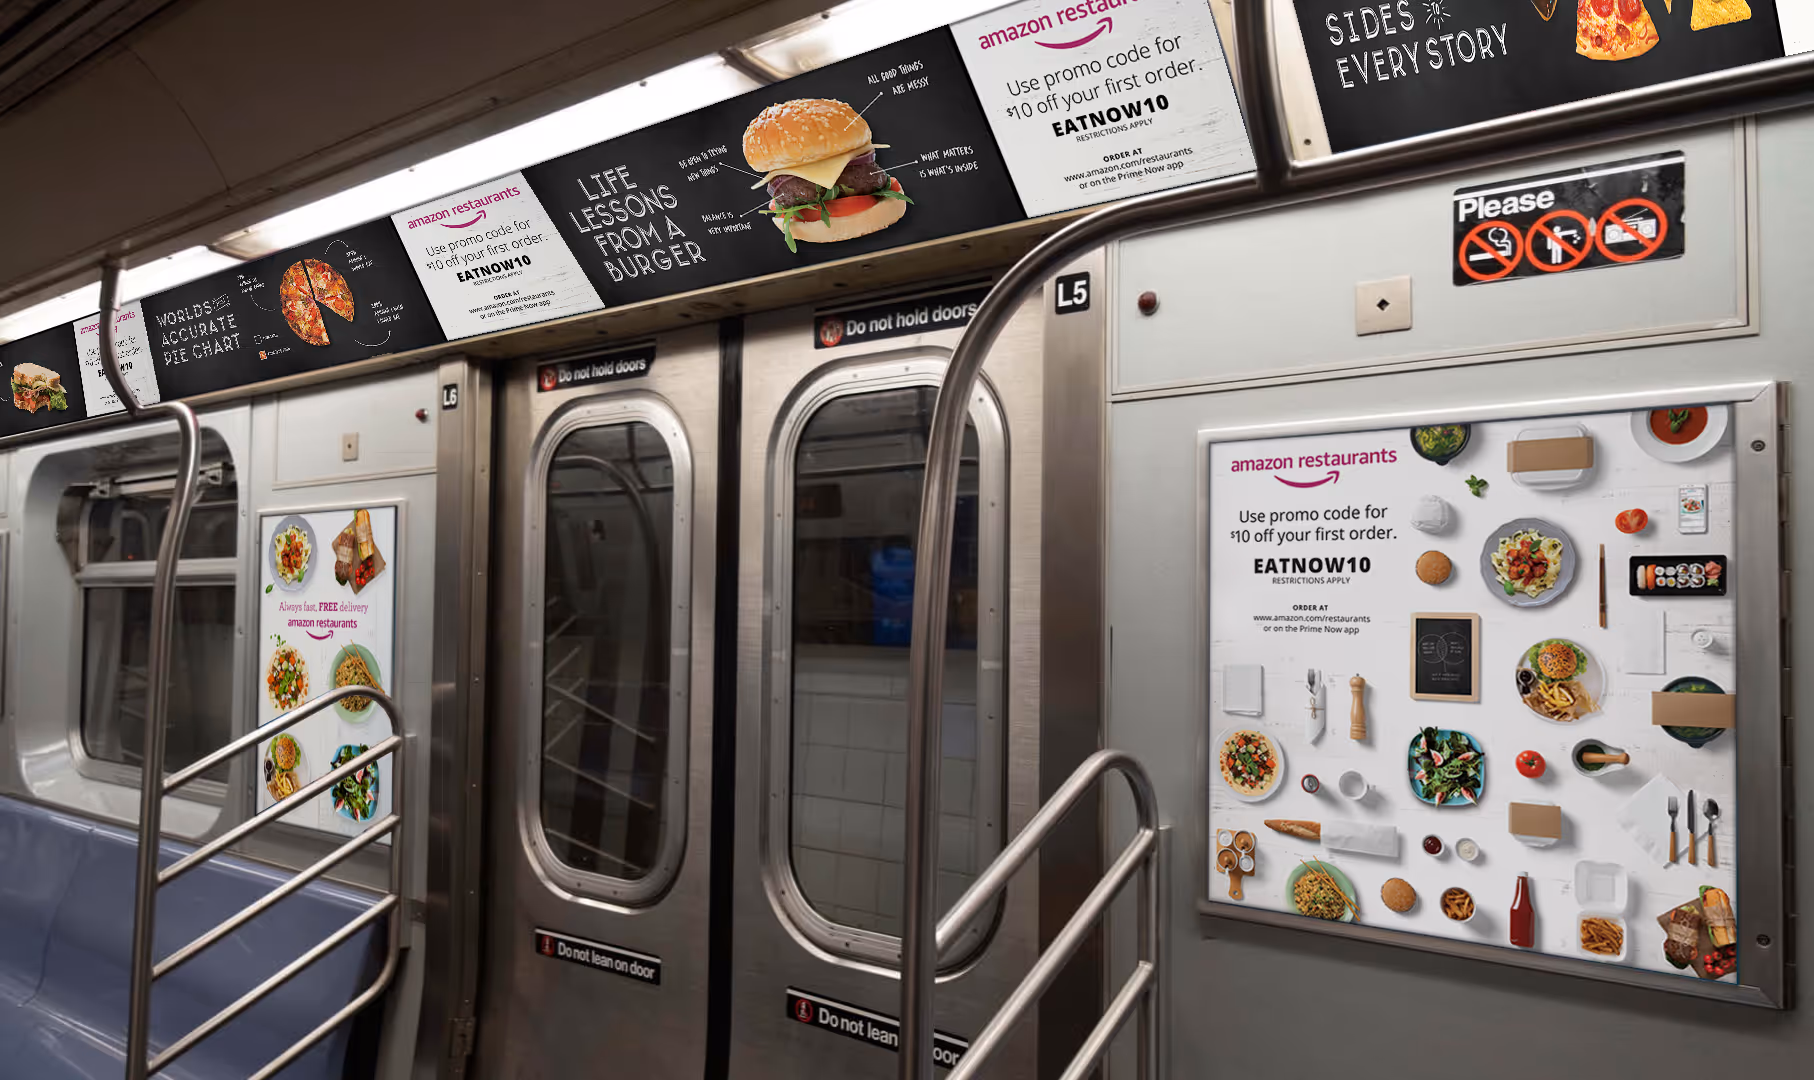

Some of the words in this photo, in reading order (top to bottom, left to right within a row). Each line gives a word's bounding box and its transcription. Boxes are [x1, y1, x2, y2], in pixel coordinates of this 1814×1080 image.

[979, 15, 1053, 49] amazon
[1325, 0, 1415, 46] SIDES
[1007, 79, 1040, 97] Use
[1043, 60, 1102, 88] promo
[1107, 44, 1152, 69] code
[1155, 34, 1182, 53] for
[1336, 41, 1419, 89] EVERY
[1425, 22, 1508, 70] STORY
[867, 74, 879, 85] ALL
[880, 68, 898, 82] GOOD
[898, 60, 924, 75] THINGS
[892, 83, 906, 95] ARE
[907, 76, 929, 91] MESSY
[1006, 103, 1033, 121] $10
[1037, 90, 1060, 114] off
[1061, 85, 1100, 113] your
[1104, 74, 1142, 97] first
[1145, 58, 1203, 85] order.
[1051, 94, 1170, 138] EATNOW10
[1076, 124, 1128, 143] RESTRICTIONS
[1129, 118, 1153, 131] APPLY
[920, 150, 940, 162] WHAT
[942, 146, 974, 159] MATTERS
[1063, 147, 1193, 183] www.amazon.com/restaurants
[1103, 151, 1131, 163] ORDER
[1132, 148, 1143, 156] AT
[577, 164, 638, 201] LIFE
[919, 169, 926, 178] IS
[927, 165, 954, 177] WHAT'S
[954, 161, 979, 173] INSIDE
[1079, 181, 1088, 190] or
[1089, 178, 1102, 188] on
[1102, 173, 1117, 185] the
[1117, 168, 1144, 181] Prime
[1144, 164, 1165, 176] Now
[1166, 160, 1185, 172] app
[408, 209, 450, 229] amazon
[452, 187, 520, 215] restaurants
[569, 184, 678, 234] LESSONS
[1459, 190, 1555, 222] Please
[426, 245, 447, 257] Use
[448, 235, 483, 253] promo
[486, 225, 513, 240] code
[514, 220, 531, 231] for
[594, 221, 663, 257] FROM
[664, 215, 686, 240] A
[446, 255, 460, 267] off
[461, 250, 485, 266] your
[487, 243, 510, 256] first
[512, 233, 548, 249] order.
[603, 240, 707, 282] BURGER
[456, 255, 531, 282] EATNOW10
[494, 292, 512, 300] ORDER
[1057, 280, 1088, 307] L5
[496, 308, 506, 316] the
[846, 319, 866, 336] Do
[870, 314, 893, 333] not
[896, 307, 929, 329] hold
[932, 302, 977, 321] doors
[162, 313, 238, 348] ACCURATE
[192, 332, 240, 359] CHART
[558, 369, 572, 383] Do
[574, 366, 590, 381] not
[592, 361, 614, 377] hold
[616, 358, 646, 374] doors
[443, 388, 457, 406] L6
[1231, 456, 1293, 472] amazon
[1298, 448, 1397, 468] restaurants
[1239, 509, 1266, 524] Use
[1270, 509, 1319, 527] promo
[1323, 505, 1361, 521] code
[1364, 504, 1388, 519] for
[1230, 529, 1251, 543] $10
[1254, 528, 1274, 543] off
[1277, 528, 1311, 546] your
[1315, 526, 1345, 542] first
[1349, 525, 1397, 540] order.
[1254, 556, 1371, 574] EATNOW10
[1272, 577, 1325, 585] RESTRICTIONS
[1326, 577, 1351, 585] APPLY
[279, 601, 303, 614] Always
[303, 601, 317, 613] fast,
[319, 602, 338, 612] FREE
[339, 601, 369, 614] delivery
[1253, 614, 1371, 624] www.amazon.com/restaurants
[1292, 604, 1317, 612] ORDER
[288, 619, 315, 628] amazon
[316, 618, 358, 629] restaurants
[1285, 624, 1298, 633] the
[1300, 624, 1323, 633] Prime
[1324, 625, 1342, 634] Now
[1344, 627, 1360, 635] app
[558, 942, 572, 957] Do
[573, 949, 590, 962] not
[591, 951, 613, 969] lean
[615, 959, 628, 973] on
[630, 961, 655, 979] door
[818, 1008, 839, 1028] Do
[841, 1018, 864, 1036] not
[867, 1022, 898, 1047] lean
[933, 1047, 959, 1065] oor
